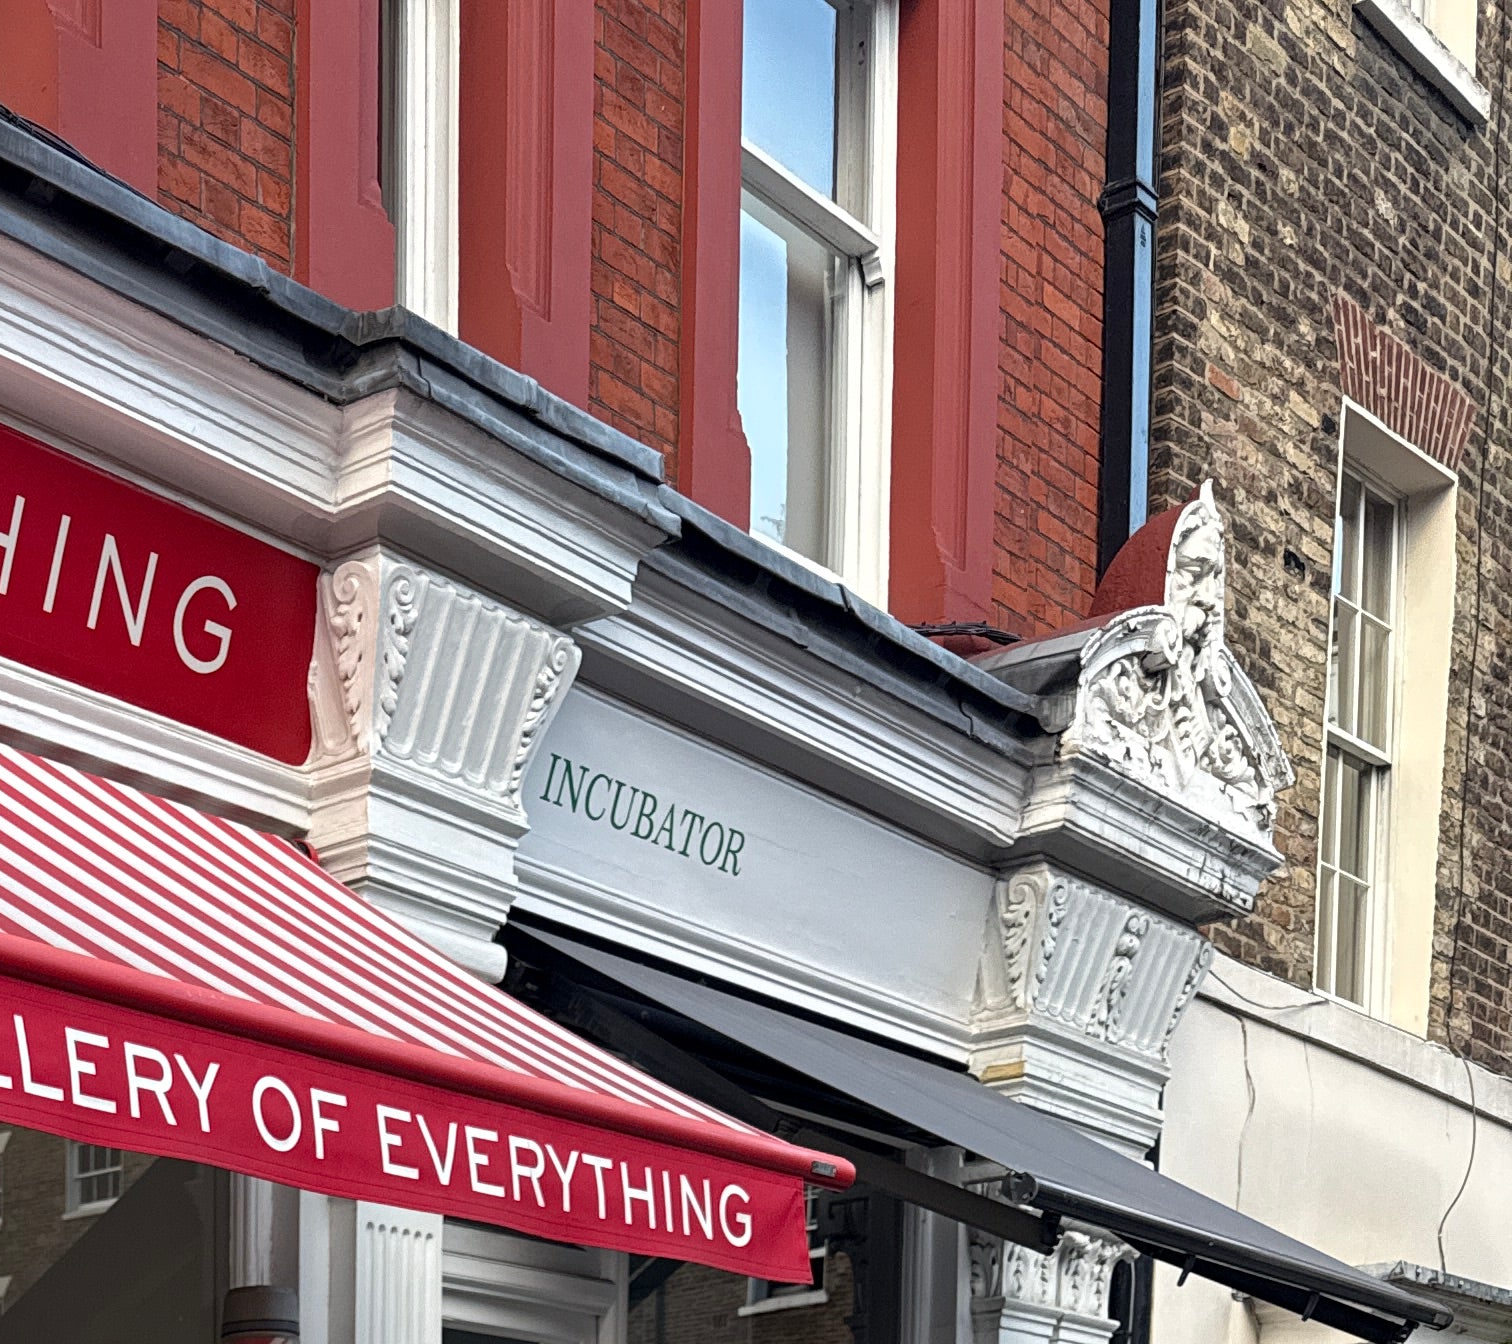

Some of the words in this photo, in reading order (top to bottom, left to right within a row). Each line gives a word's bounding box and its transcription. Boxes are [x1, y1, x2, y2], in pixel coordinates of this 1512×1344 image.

[539, 753, 746, 876] INCUBATOR
[252, 1075, 347, 1160] OF
[377, 1103, 753, 1249] EVERYTHING
